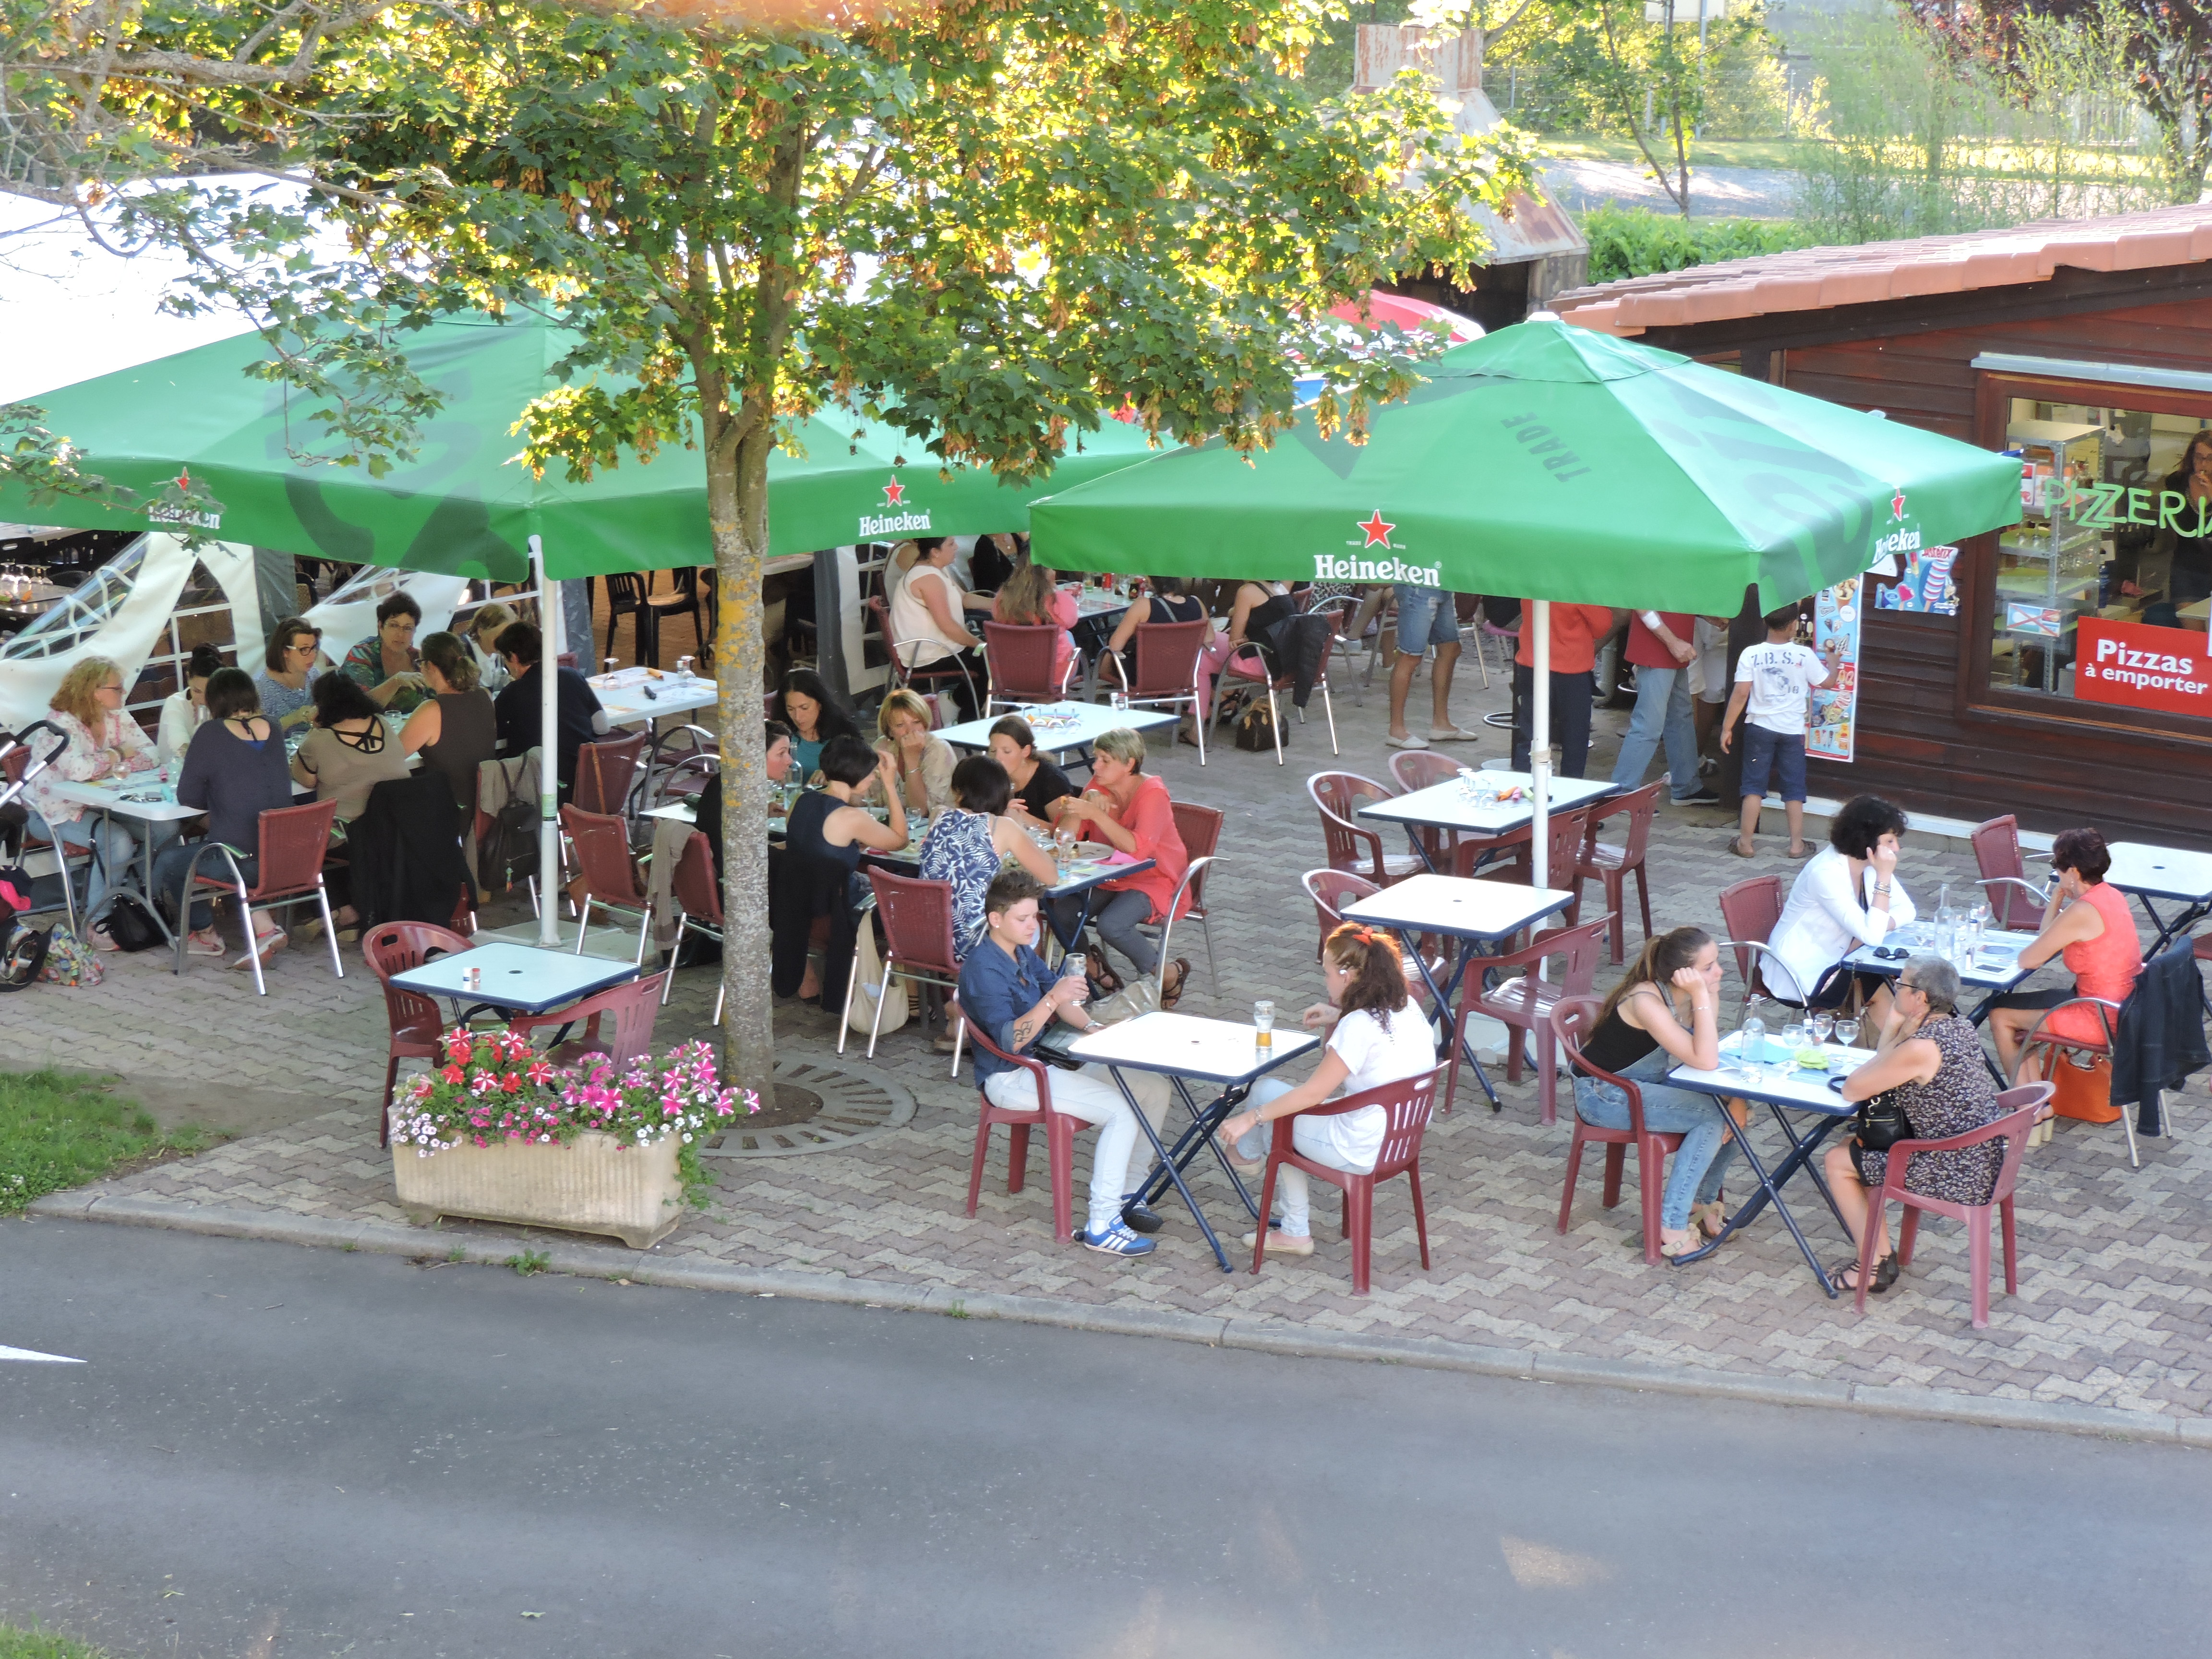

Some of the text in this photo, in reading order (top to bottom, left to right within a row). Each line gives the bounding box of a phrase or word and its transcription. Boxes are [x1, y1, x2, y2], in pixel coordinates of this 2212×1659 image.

[1500, 411, 1592, 482] TRADE
[859, 511, 931, 537] Heineken
[1313, 554, 1440, 587] Heineken
[2096, 638, 2193, 674] Pizzas
[2084, 662, 2209, 695] à emporter
